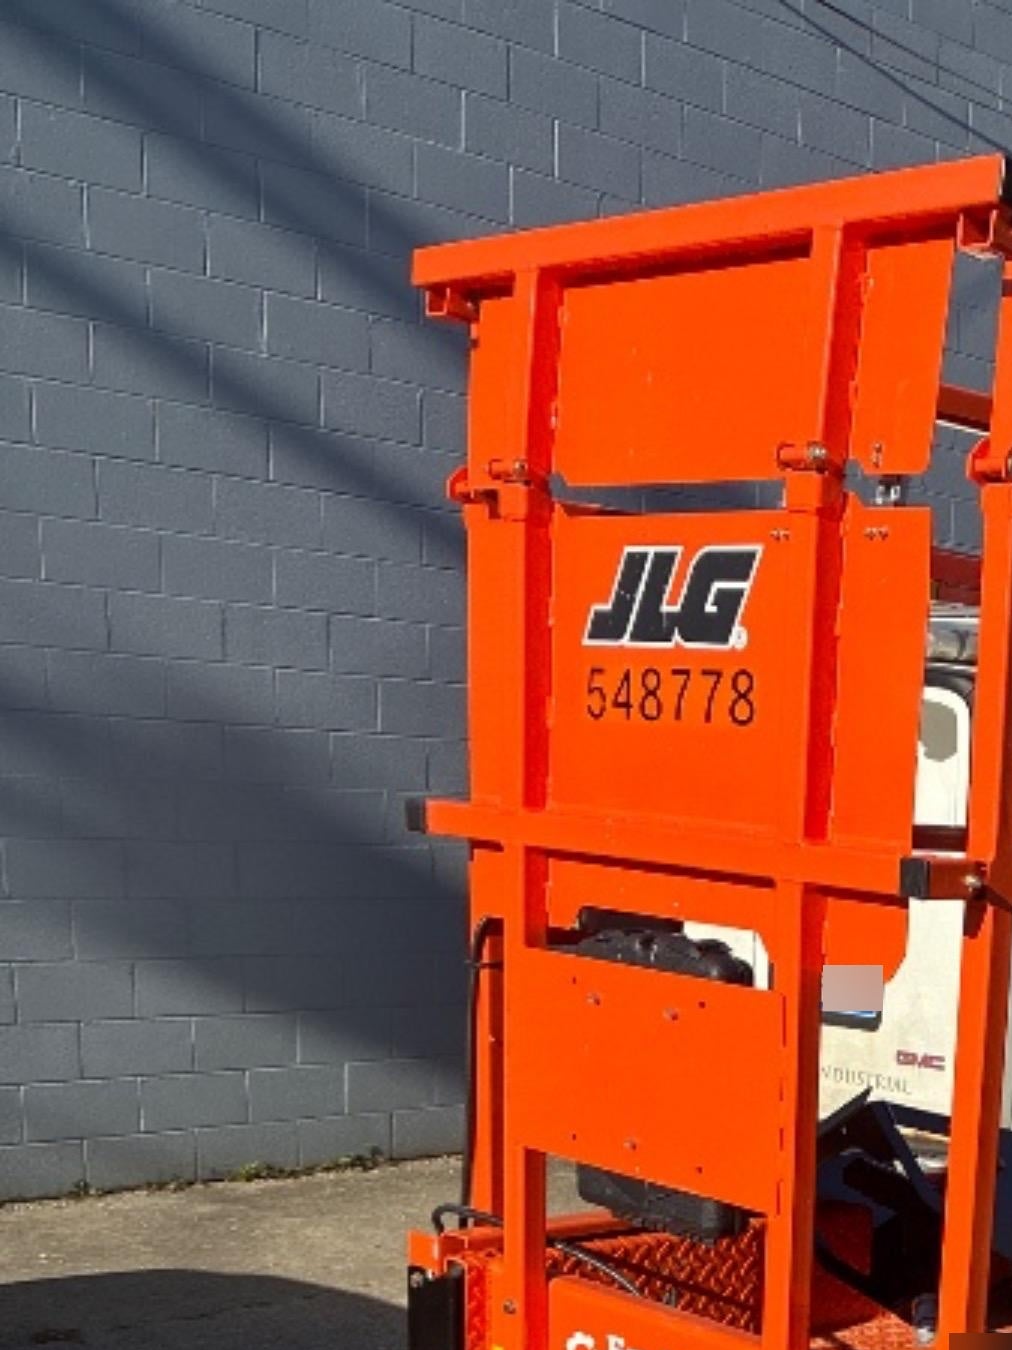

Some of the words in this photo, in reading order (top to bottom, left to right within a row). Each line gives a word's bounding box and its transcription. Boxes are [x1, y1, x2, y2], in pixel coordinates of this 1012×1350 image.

[582, 545, 765, 650] JLG
[586, 667, 755, 727] 548778
[896, 1050, 946, 1071] GMC
